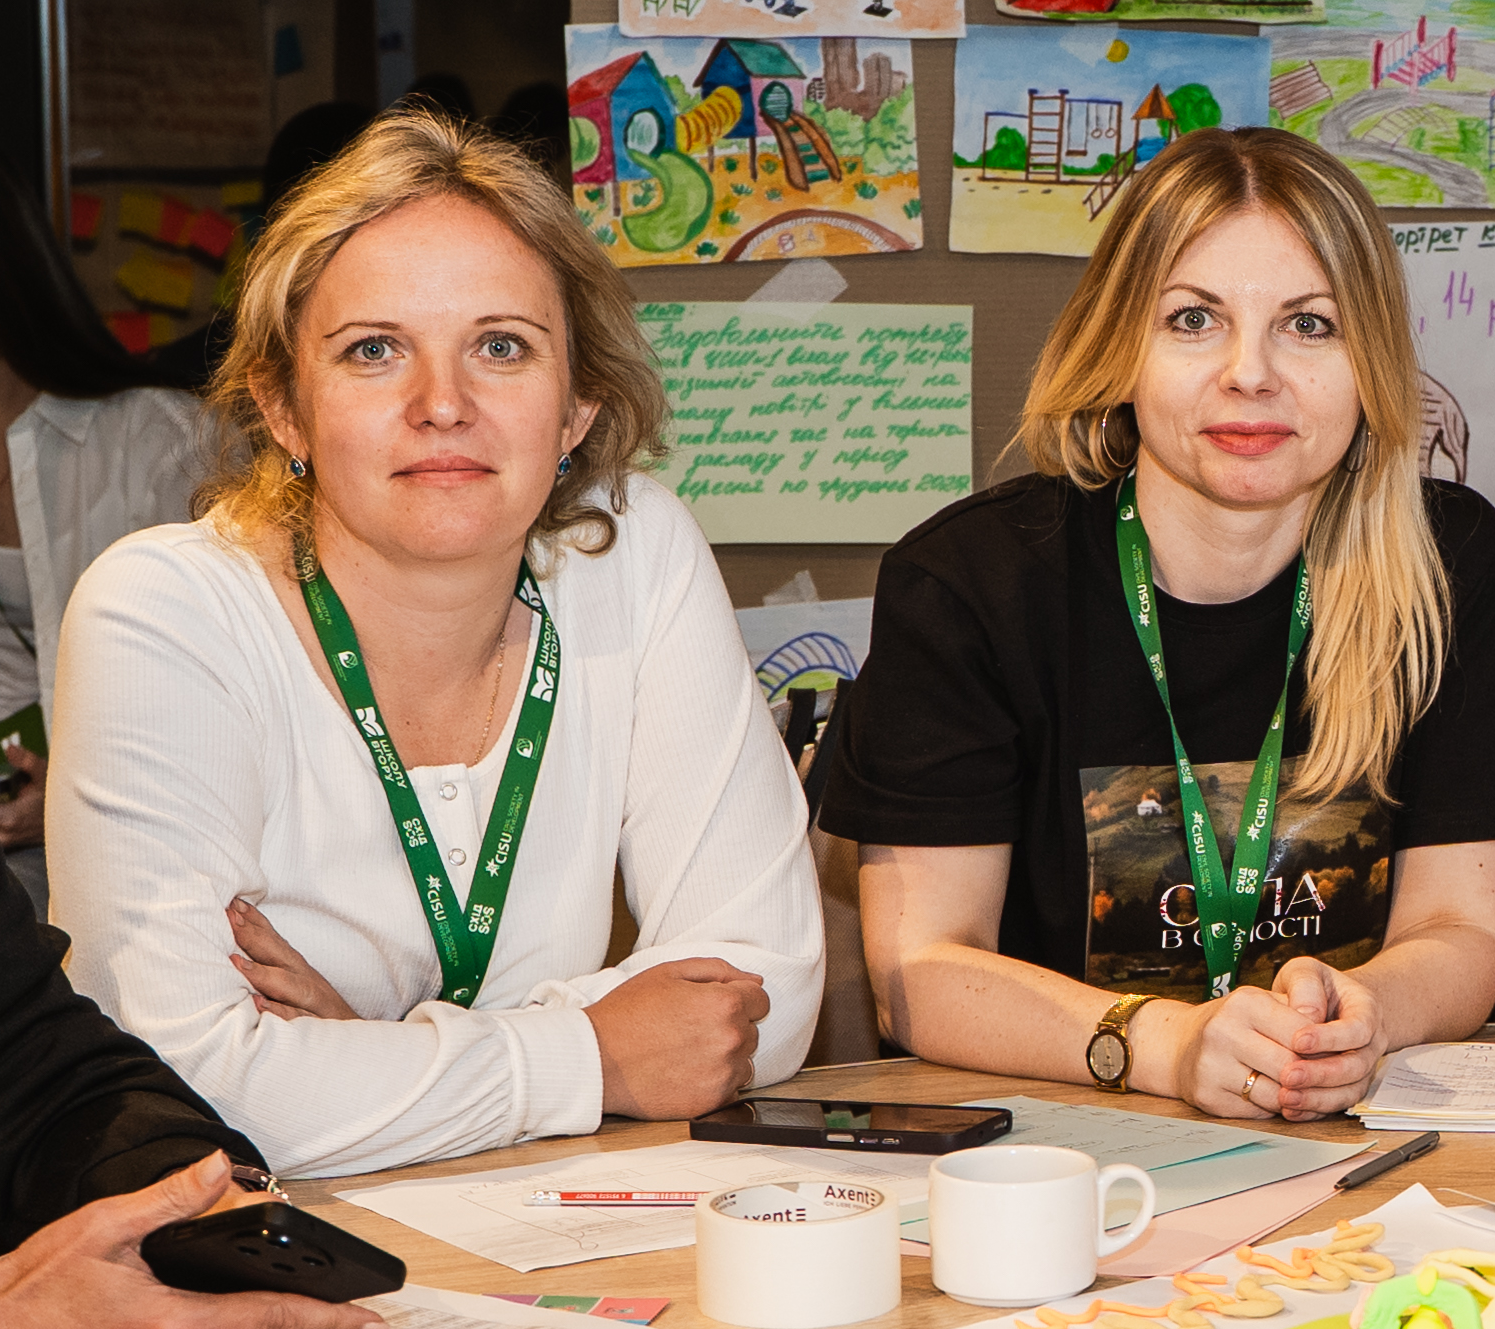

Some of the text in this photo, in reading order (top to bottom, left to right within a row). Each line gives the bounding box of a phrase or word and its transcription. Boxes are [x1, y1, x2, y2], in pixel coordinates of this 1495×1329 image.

[1443, 271, 1474, 319] 14
[922, 373, 961, 387] на
[843, 426, 877, 441] на
[800, 448, 819, 470] у
[1139, 583, 1151, 616] CISU
[371, 740, 395, 782] ВГОРУ
[381, 739, 407, 788] ШКОЛУ
[1255, 798, 1270, 830] CISU
[403, 820, 419, 847] SOS
[412, 817, 427, 846] СХІД
[1191, 826, 1205, 854] CISU
[494, 831, 513, 866] CISU
[1236, 867, 1248, 894] СХІД
[1245, 868, 1259, 895] SOS
[427, 889, 445, 921] CISU
[468, 904, 483, 933] СХІД
[479, 906, 495, 934] SOS
[823, 1185, 870, 1206] Axent
